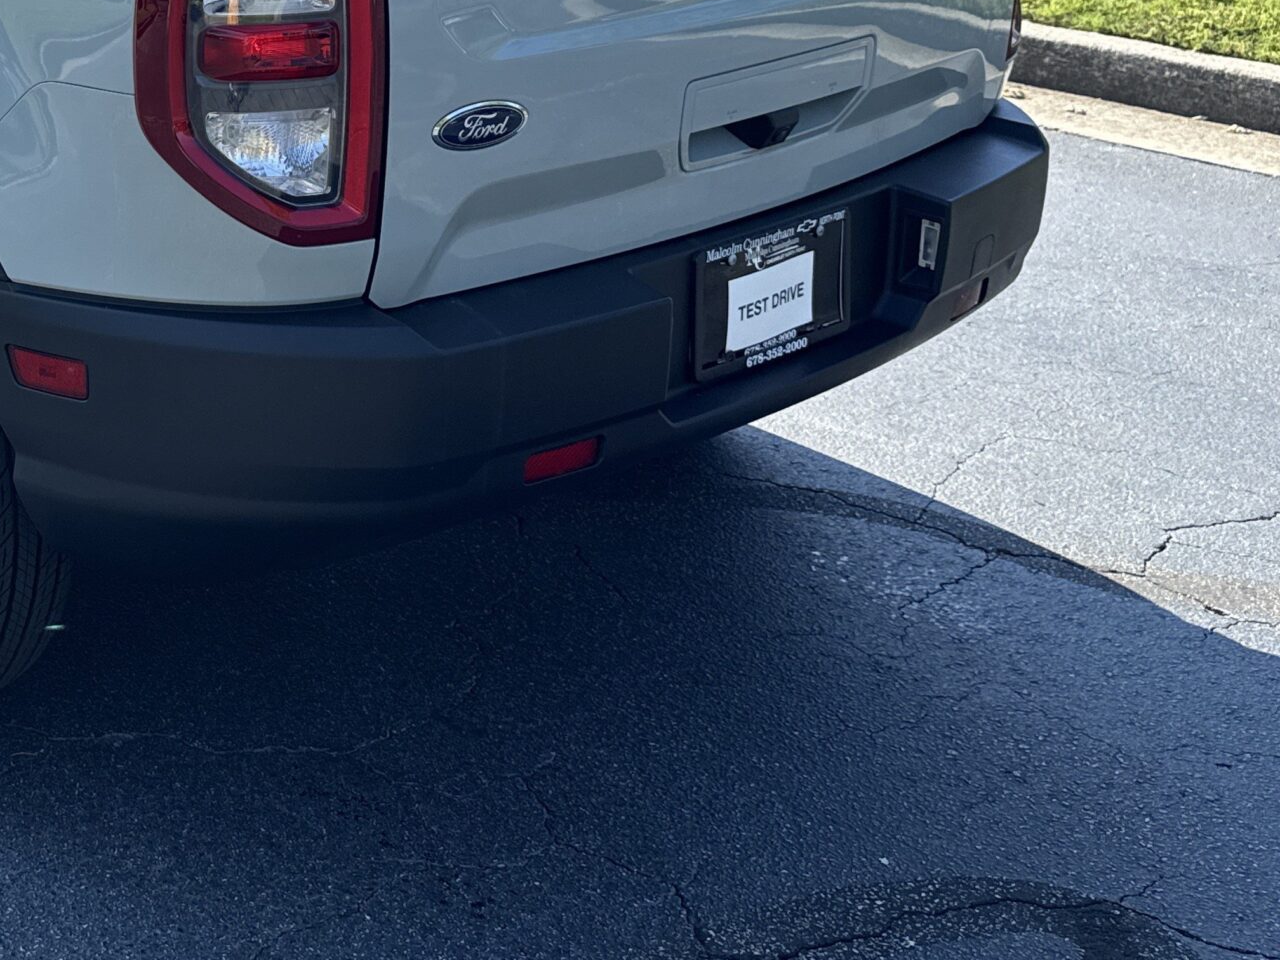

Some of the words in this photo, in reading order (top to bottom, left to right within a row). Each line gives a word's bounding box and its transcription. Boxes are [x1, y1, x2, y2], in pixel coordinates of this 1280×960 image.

[458, 112, 510, 141] Ford
[706, 242, 743, 264] Malcolm
[743, 228, 795, 251] Cunningham
[738, 296, 769, 322] TEST
[771, 281, 805, 310] DRIVE
[746, 336, 808, 369] 678-352-2000
